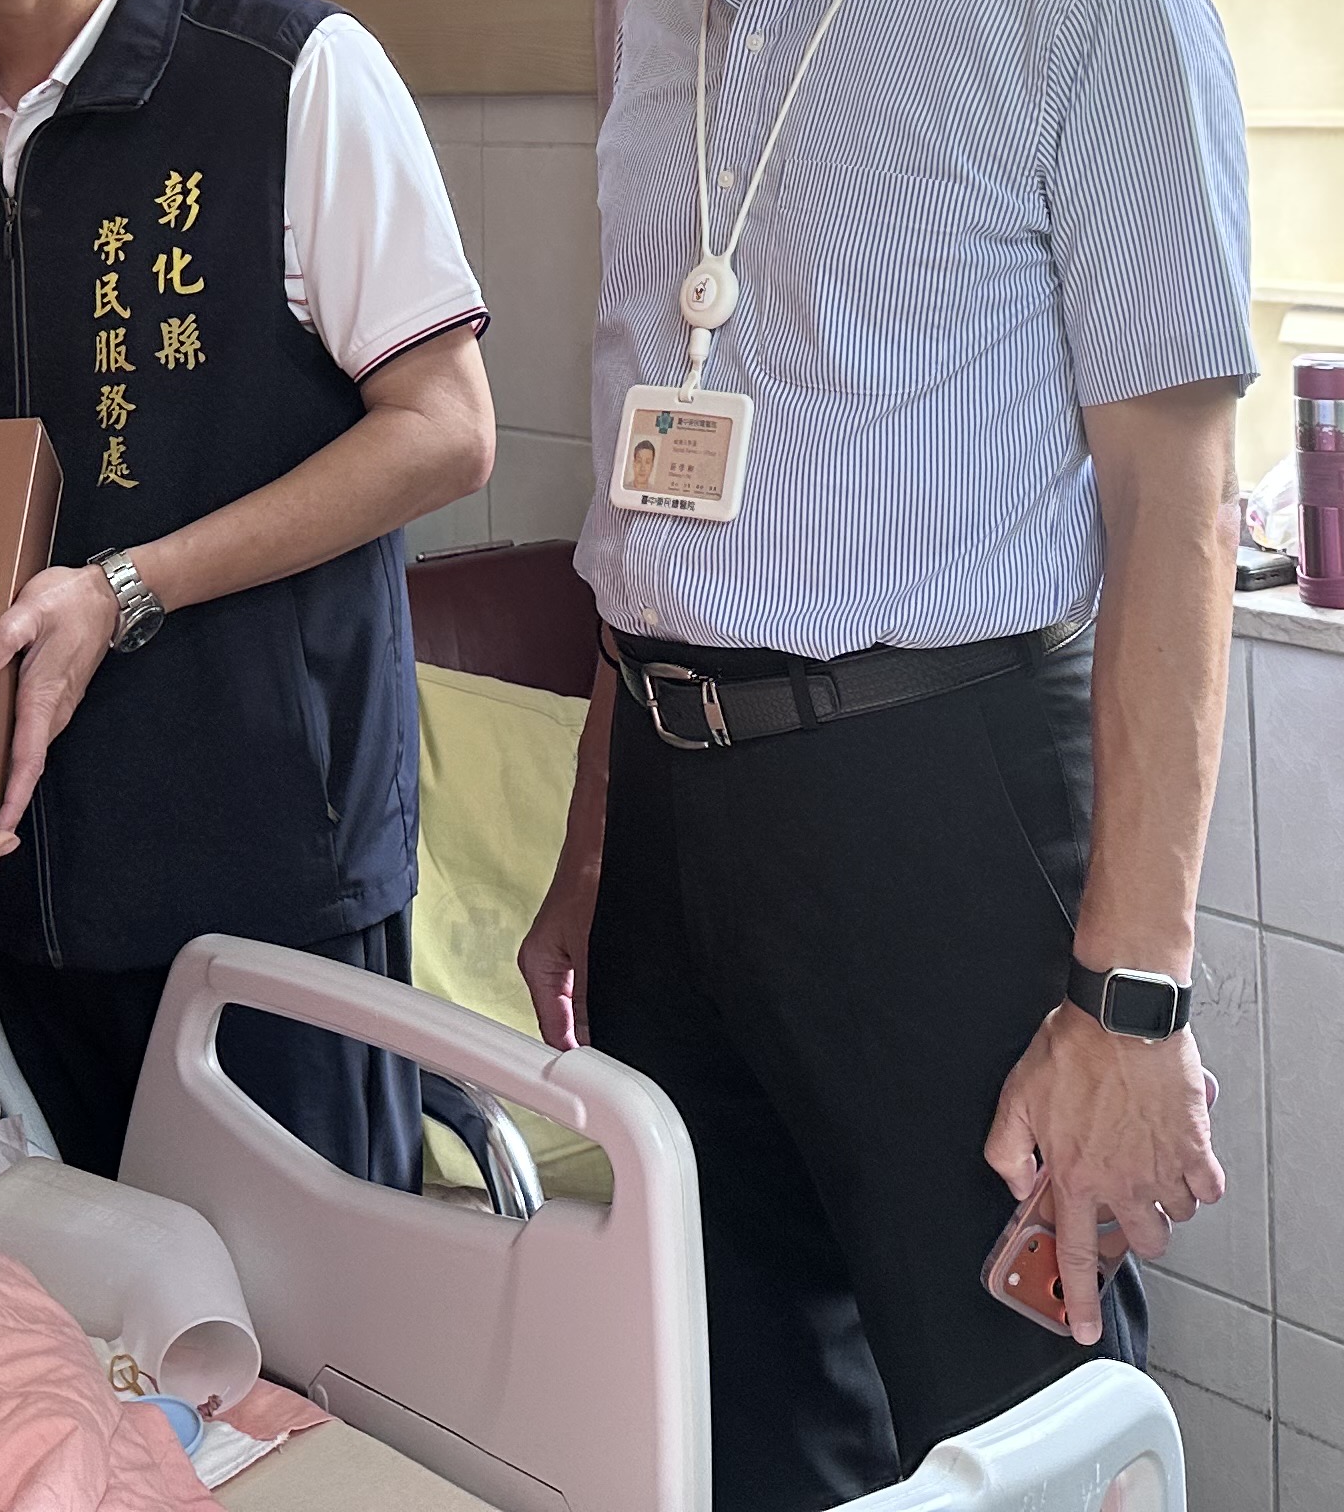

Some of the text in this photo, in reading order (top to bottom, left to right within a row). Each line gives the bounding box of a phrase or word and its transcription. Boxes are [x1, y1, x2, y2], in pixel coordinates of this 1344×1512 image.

[93, 216, 140, 489] 榮民服務處
[151, 170, 207, 372] 彰化縣
